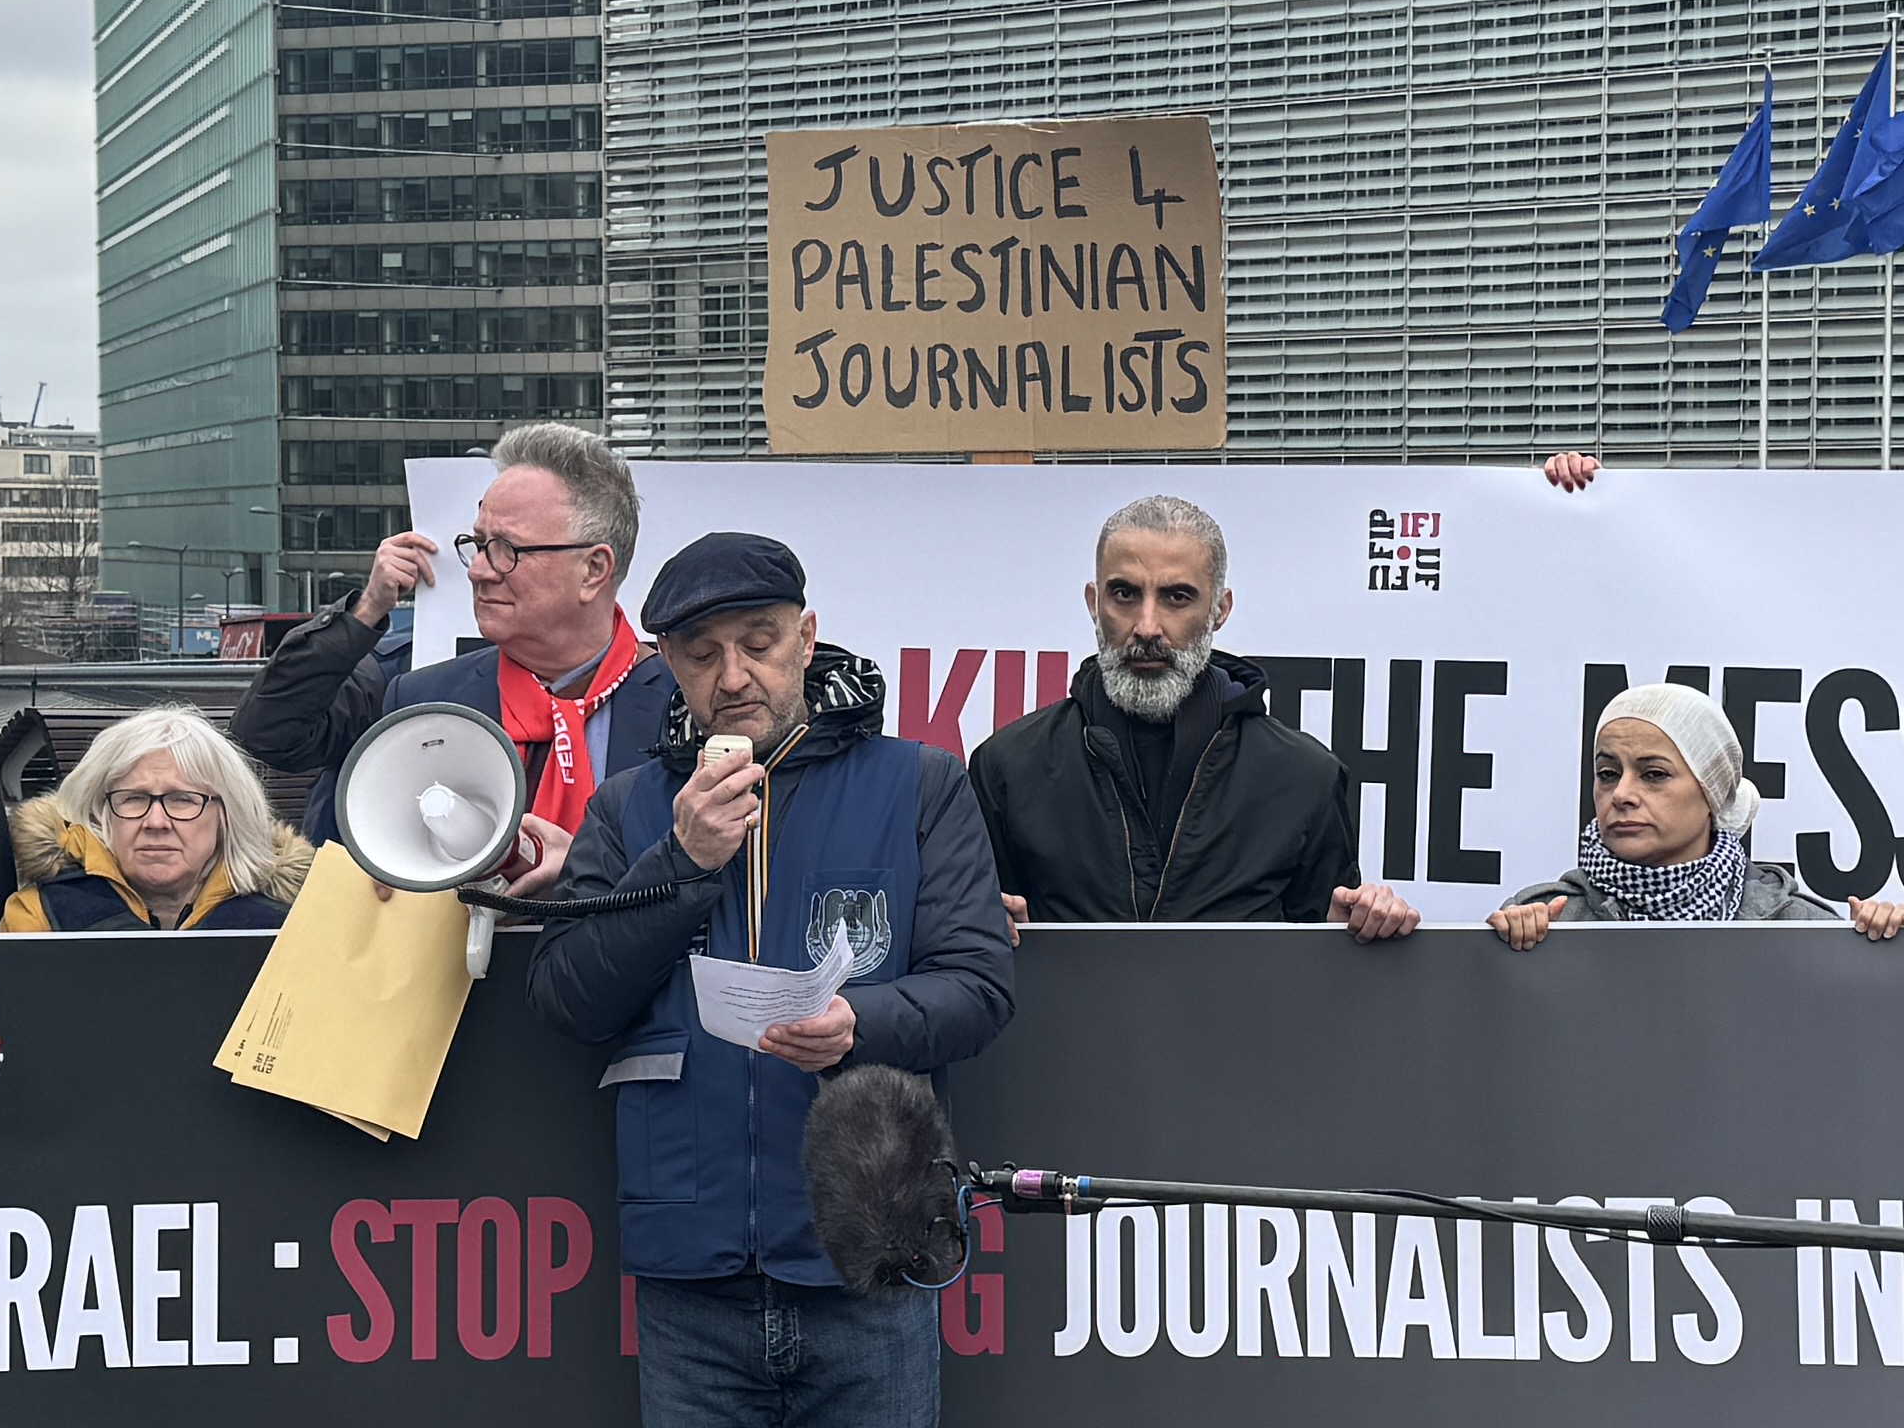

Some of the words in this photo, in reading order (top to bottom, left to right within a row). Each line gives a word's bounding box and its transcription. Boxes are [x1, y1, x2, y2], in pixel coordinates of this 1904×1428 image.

[804, 144, 1087, 220] JUSTICE
[1129, 145, 1184, 229] 4
[791, 235, 1206, 317] PALESTINIAN
[792, 327, 1209, 417] JOURNALISTS
[1400, 512, 1441, 538] IFJ
[325, 1195, 596, 1364] STOP
[1053, 1194, 1744, 1366] JOURNALISTS
